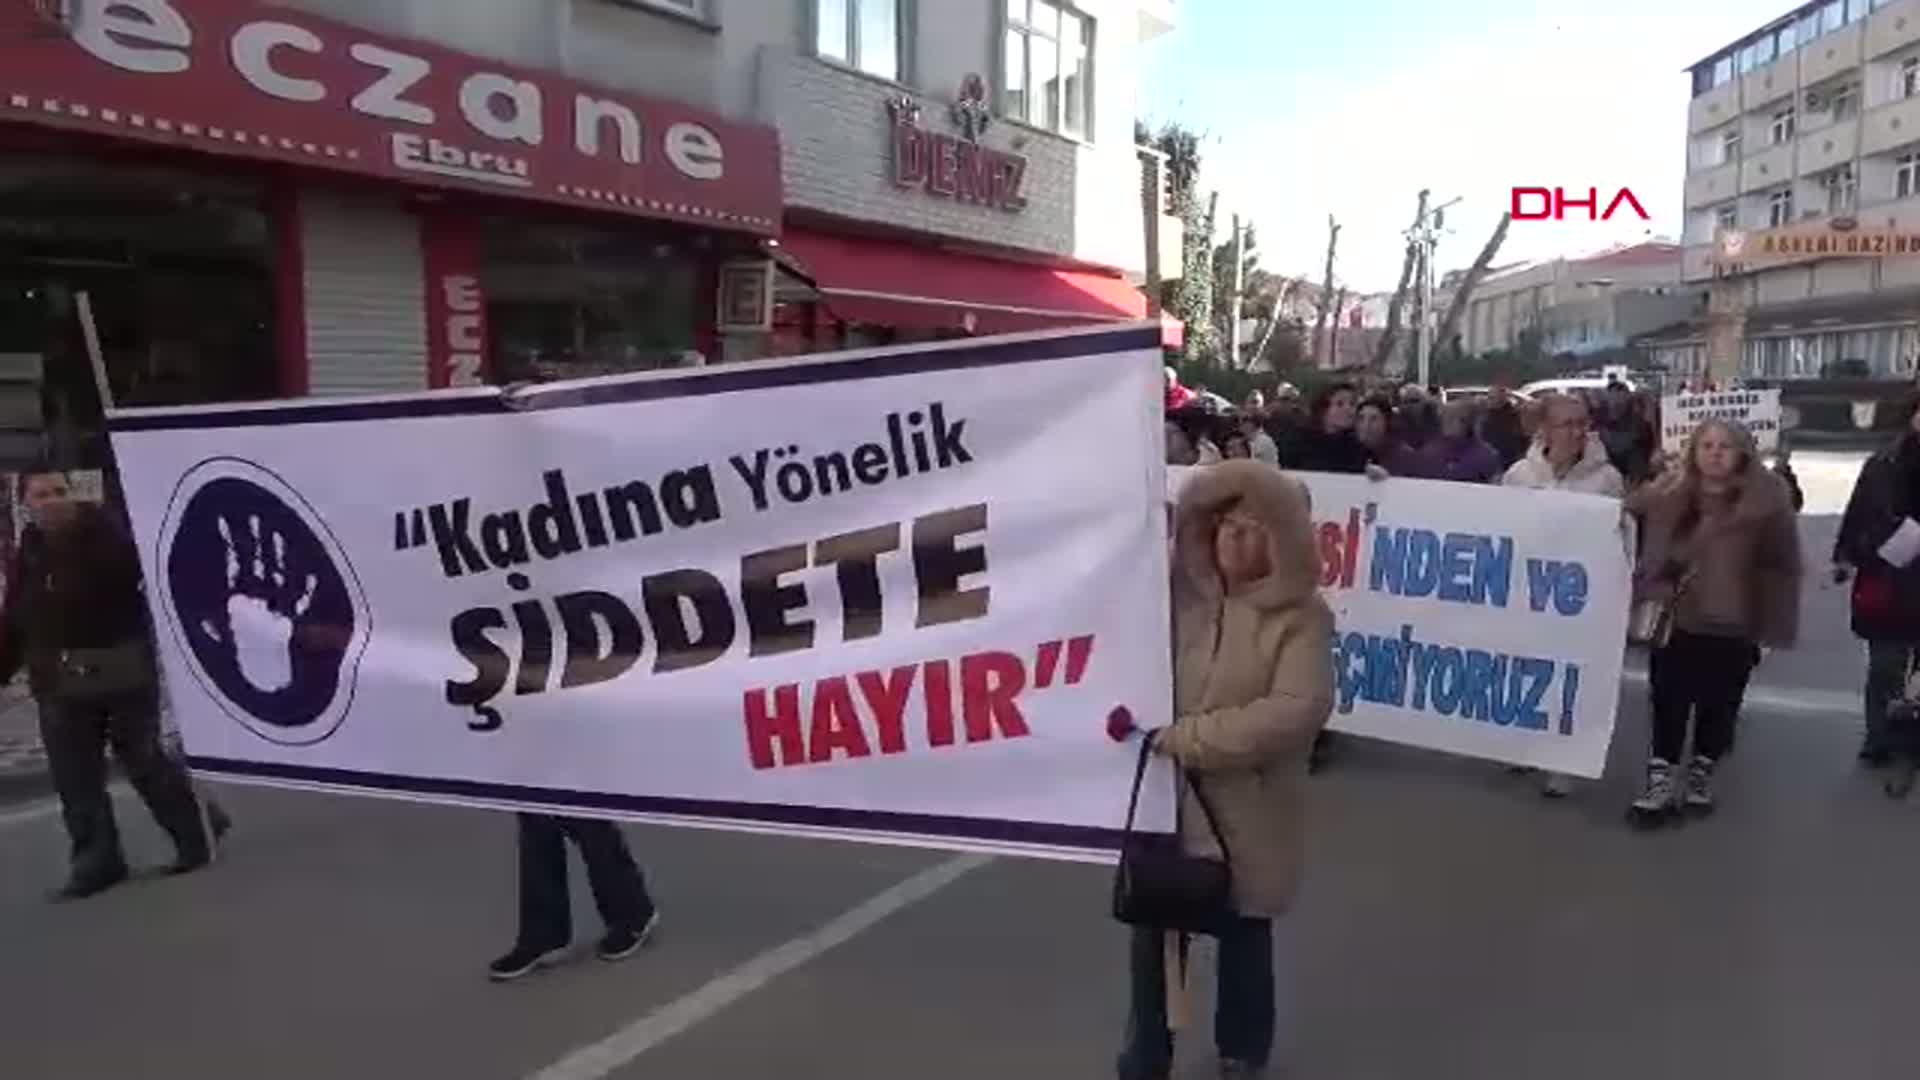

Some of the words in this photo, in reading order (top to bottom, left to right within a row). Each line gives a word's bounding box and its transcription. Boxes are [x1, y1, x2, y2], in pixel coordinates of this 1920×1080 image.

[62, 0, 725, 180] eczane
[391, 132, 529, 177] Ebru
[729, 402, 972, 511] Yönelik
[446, 502, 991, 732] ŞİDDETE
[1526, 557, 1589, 616] ve
[743, 634, 1096, 770] HAYIR"
